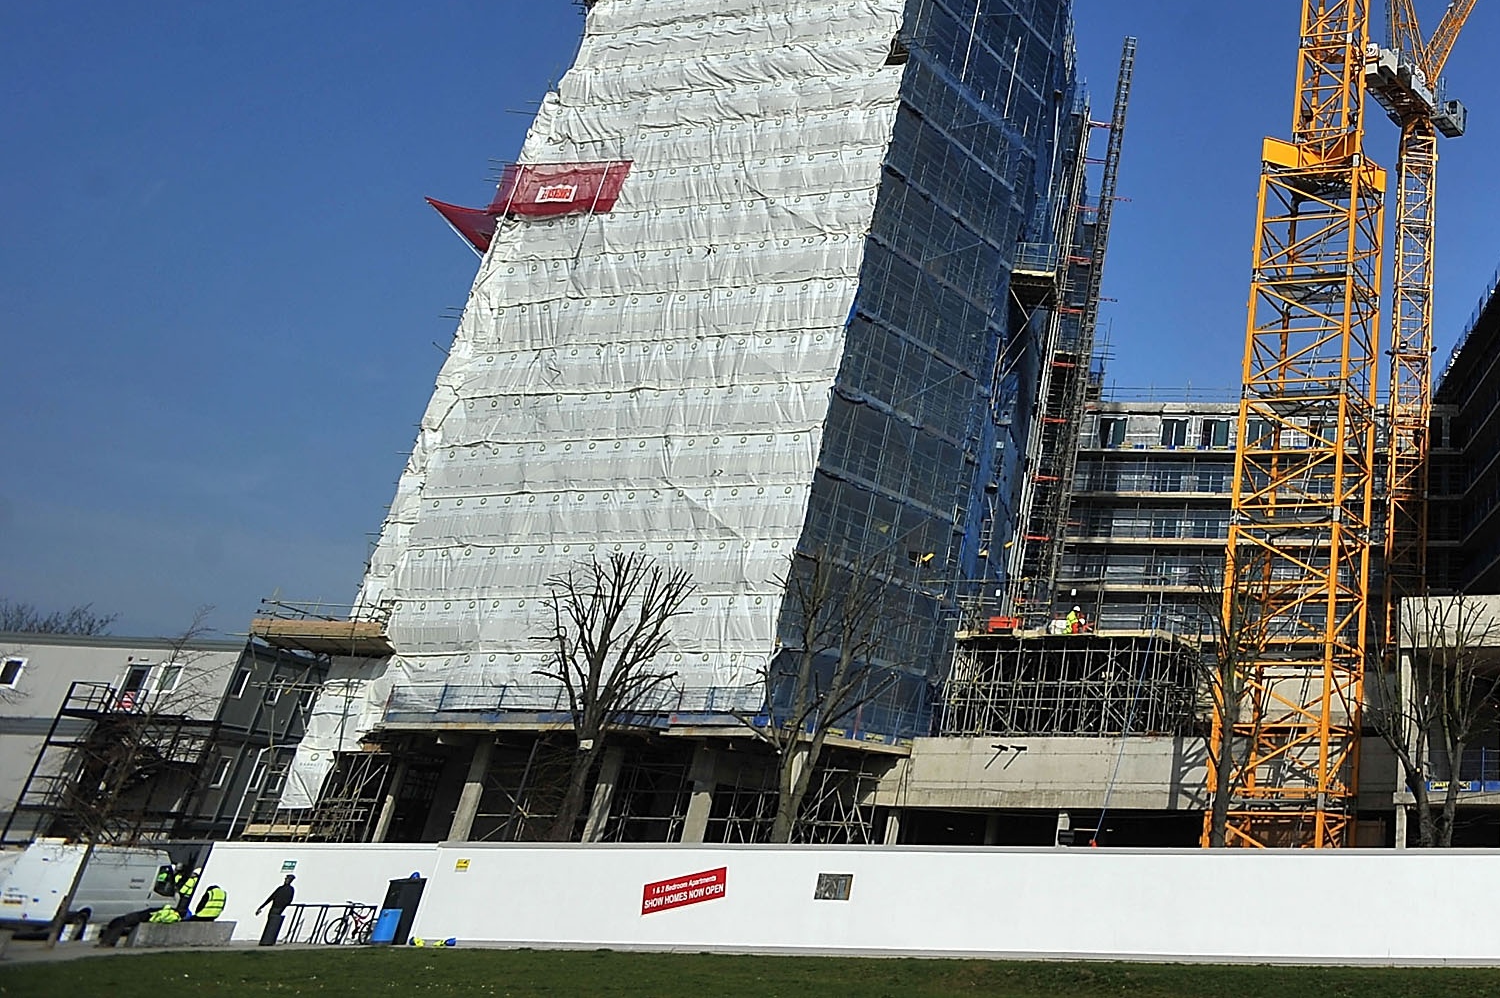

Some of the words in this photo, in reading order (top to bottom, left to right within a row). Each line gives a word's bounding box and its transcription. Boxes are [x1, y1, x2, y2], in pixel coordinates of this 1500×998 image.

[665, 880, 689, 892] Bedroom
[688, 875, 717, 887] Apartments
[644, 896, 664, 909] SHOW
[664, 891, 688, 904] HOMES
[688, 888, 705, 901] NOW
[705, 883, 724, 896] OPEN
